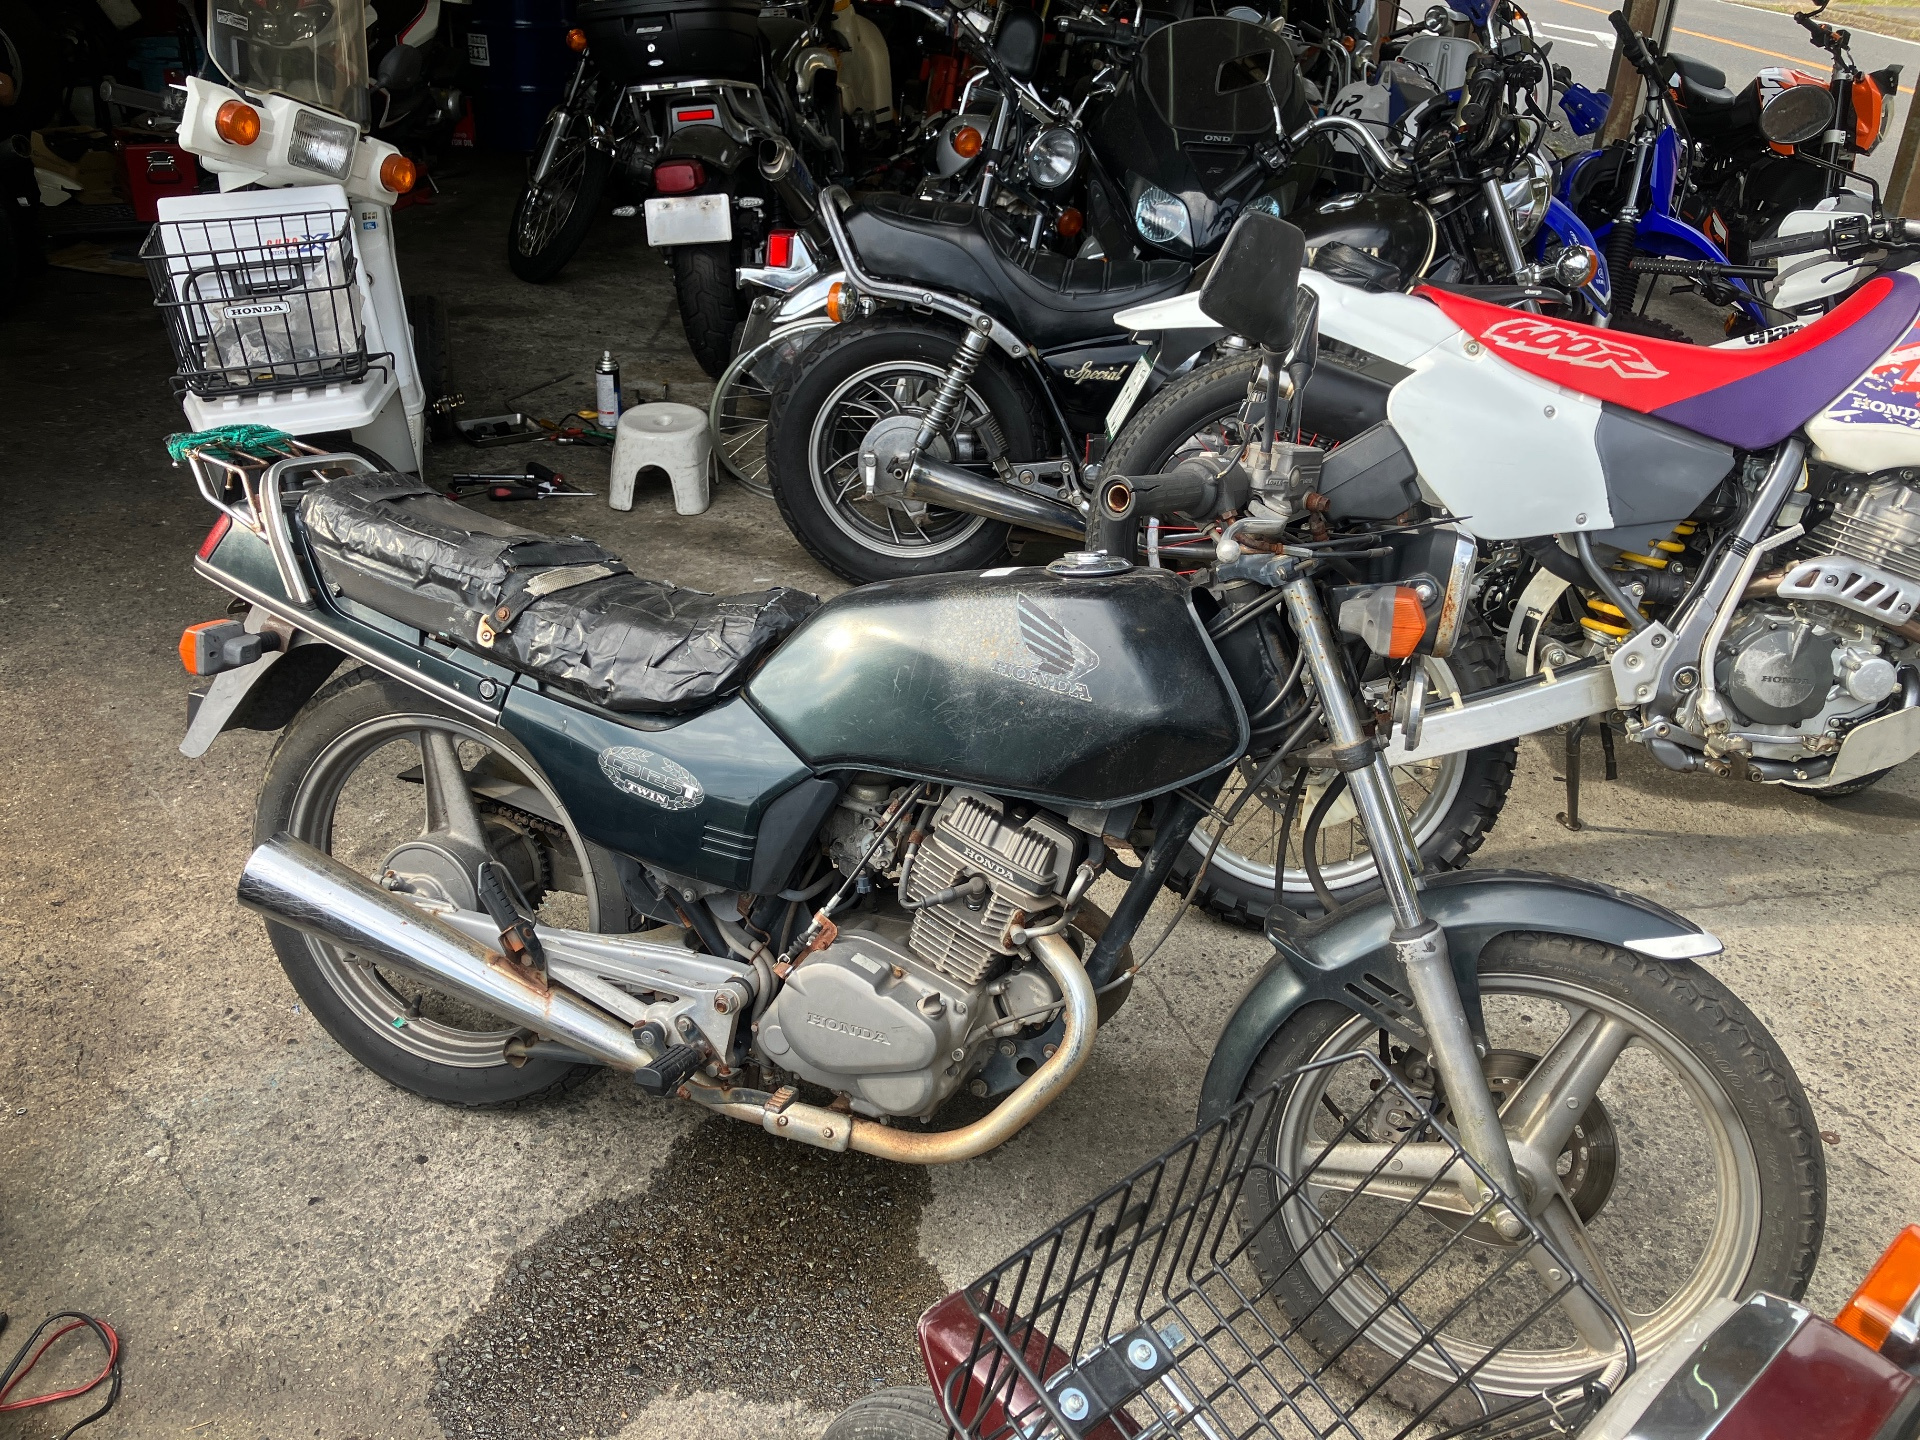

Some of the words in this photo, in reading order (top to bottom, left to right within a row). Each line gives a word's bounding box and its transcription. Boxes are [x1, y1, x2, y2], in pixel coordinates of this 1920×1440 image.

[230, 304, 284, 316] HONDA
[1063, 360, 1129, 385] Special
[1850, 396, 1920, 420] HOND
[990, 660, 1092, 703] HONDA
[625, 780, 669, 805] TWIN
[963, 847, 1015, 881] HONDA
[807, 1011, 892, 1046] HONDA
